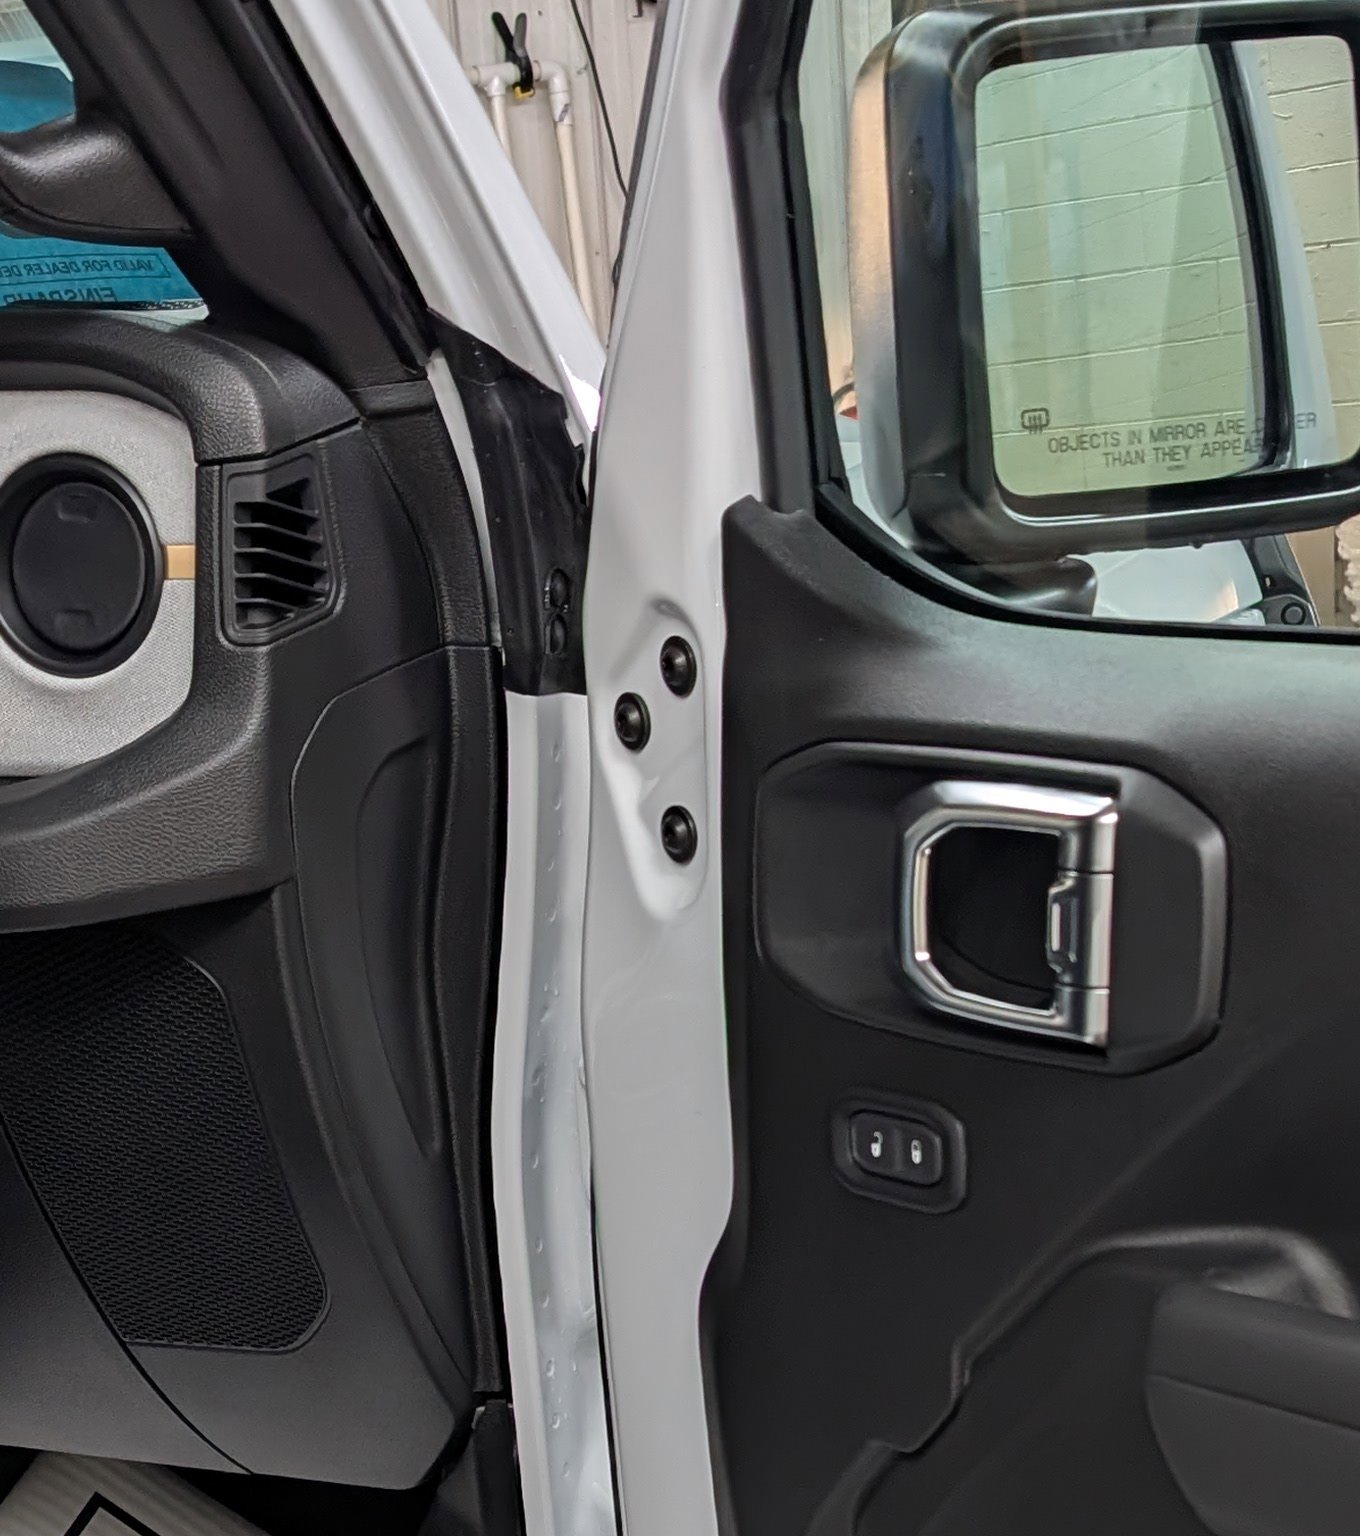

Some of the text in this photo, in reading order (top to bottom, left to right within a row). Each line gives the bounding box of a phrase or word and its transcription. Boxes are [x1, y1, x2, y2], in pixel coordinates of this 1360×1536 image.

[1048, 430, 1120, 454] OBJECTS
[1128, 428, 1142, 446] IN
[1148, 422, 1206, 445] MIRROR
[1214, 419, 1245, 437] ARE
[1103, 447, 1145, 469] THAN
[1152, 443, 1192, 463] THEY
